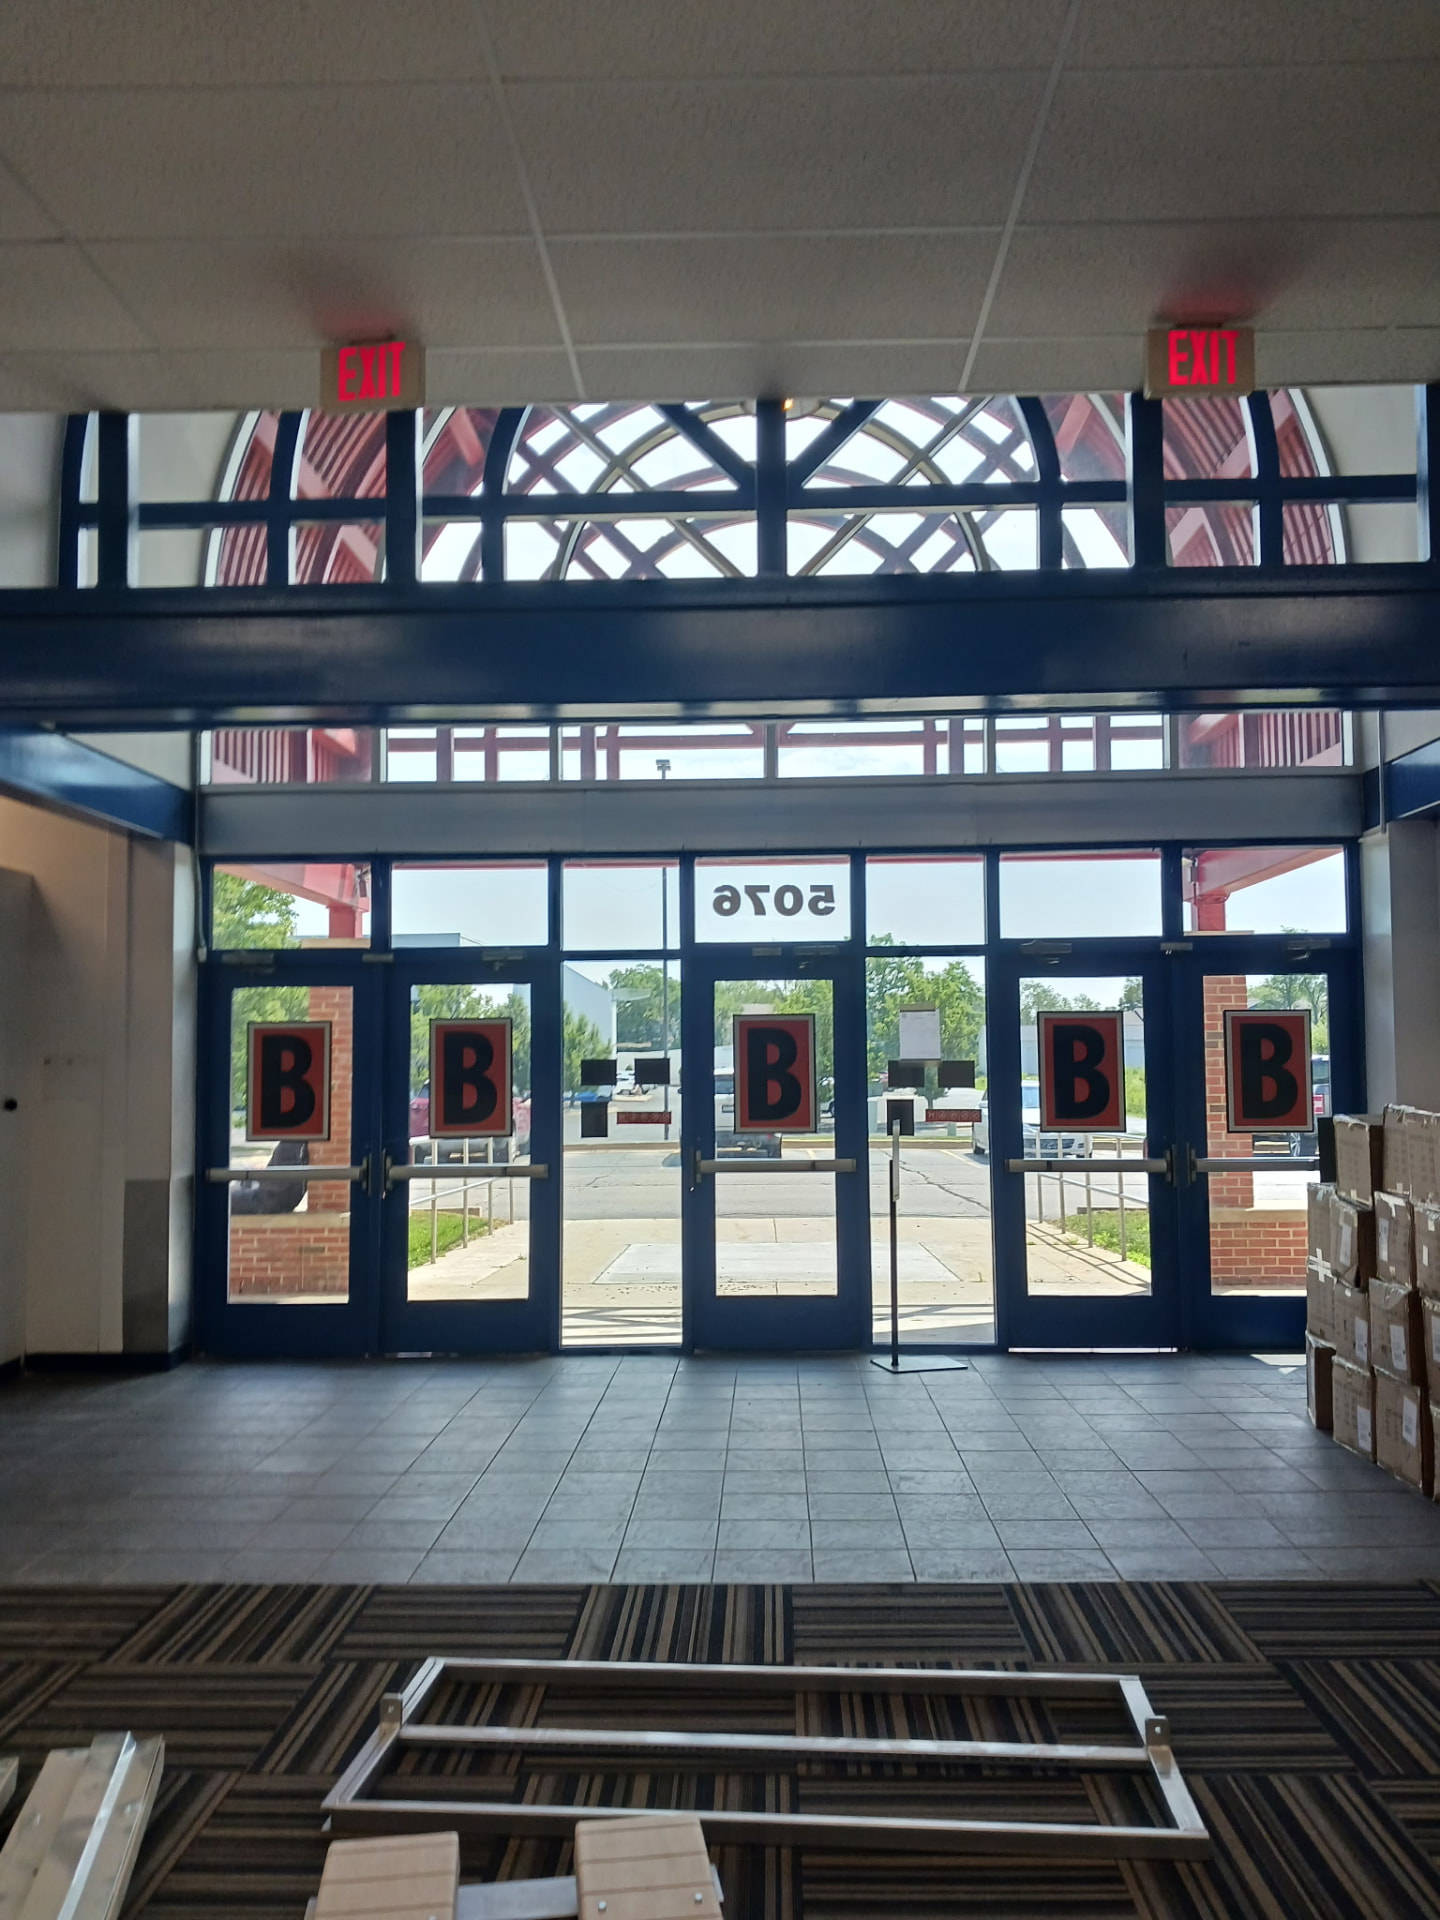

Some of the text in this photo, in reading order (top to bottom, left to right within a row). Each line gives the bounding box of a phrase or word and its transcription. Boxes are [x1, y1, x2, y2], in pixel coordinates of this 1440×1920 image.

[338, 341, 406, 402] EXIT
[1167, 330, 1240, 386] EXIT
[261, 1035, 315, 1129] B
[443, 1031, 497, 1124] B
[747, 1027, 802, 1121] B
[1053, 1024, 1110, 1120] B
[1240, 1022, 1298, 1120] B
